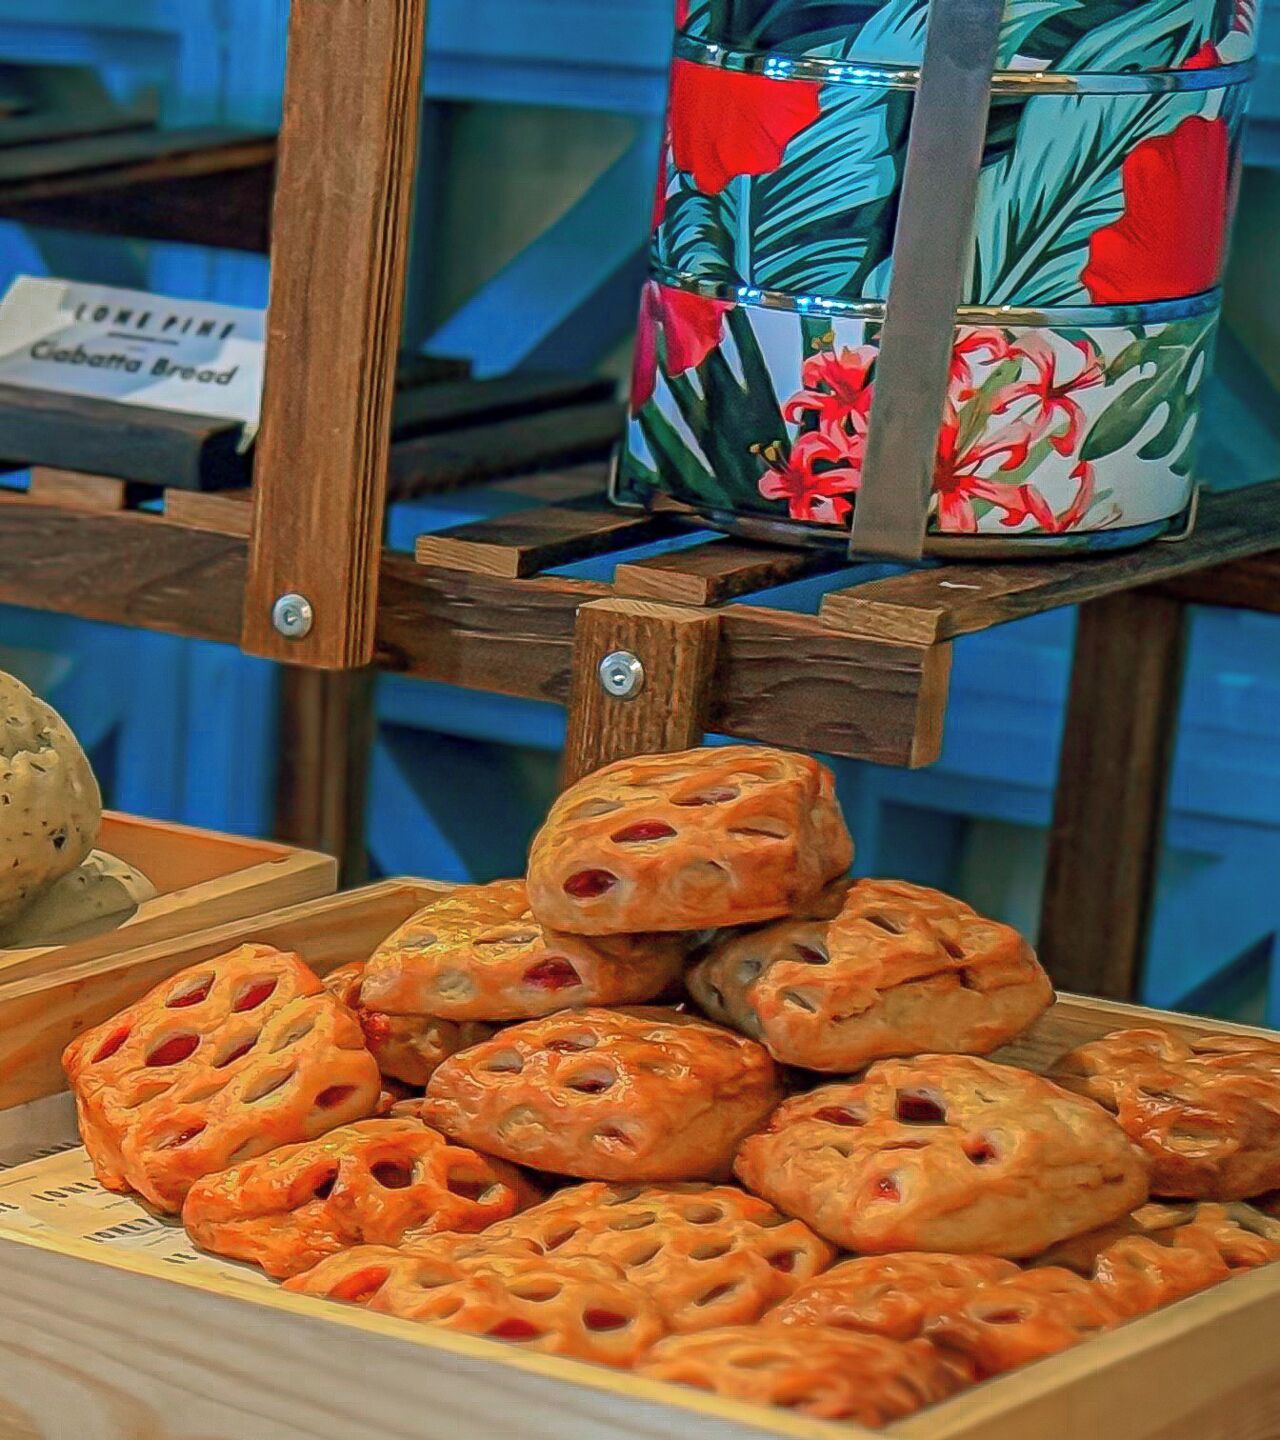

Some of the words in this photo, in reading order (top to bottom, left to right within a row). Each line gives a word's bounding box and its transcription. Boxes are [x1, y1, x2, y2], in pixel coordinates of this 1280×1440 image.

[75, 302, 151, 329] LONE
[161, 315, 235, 340] PINE
[31, 340, 142, 373] Ciabatta
[150, 357, 239, 386] Bread
[31, 1182, 98, 1202] LONE
[83, 1218, 141, 1243] LONE
